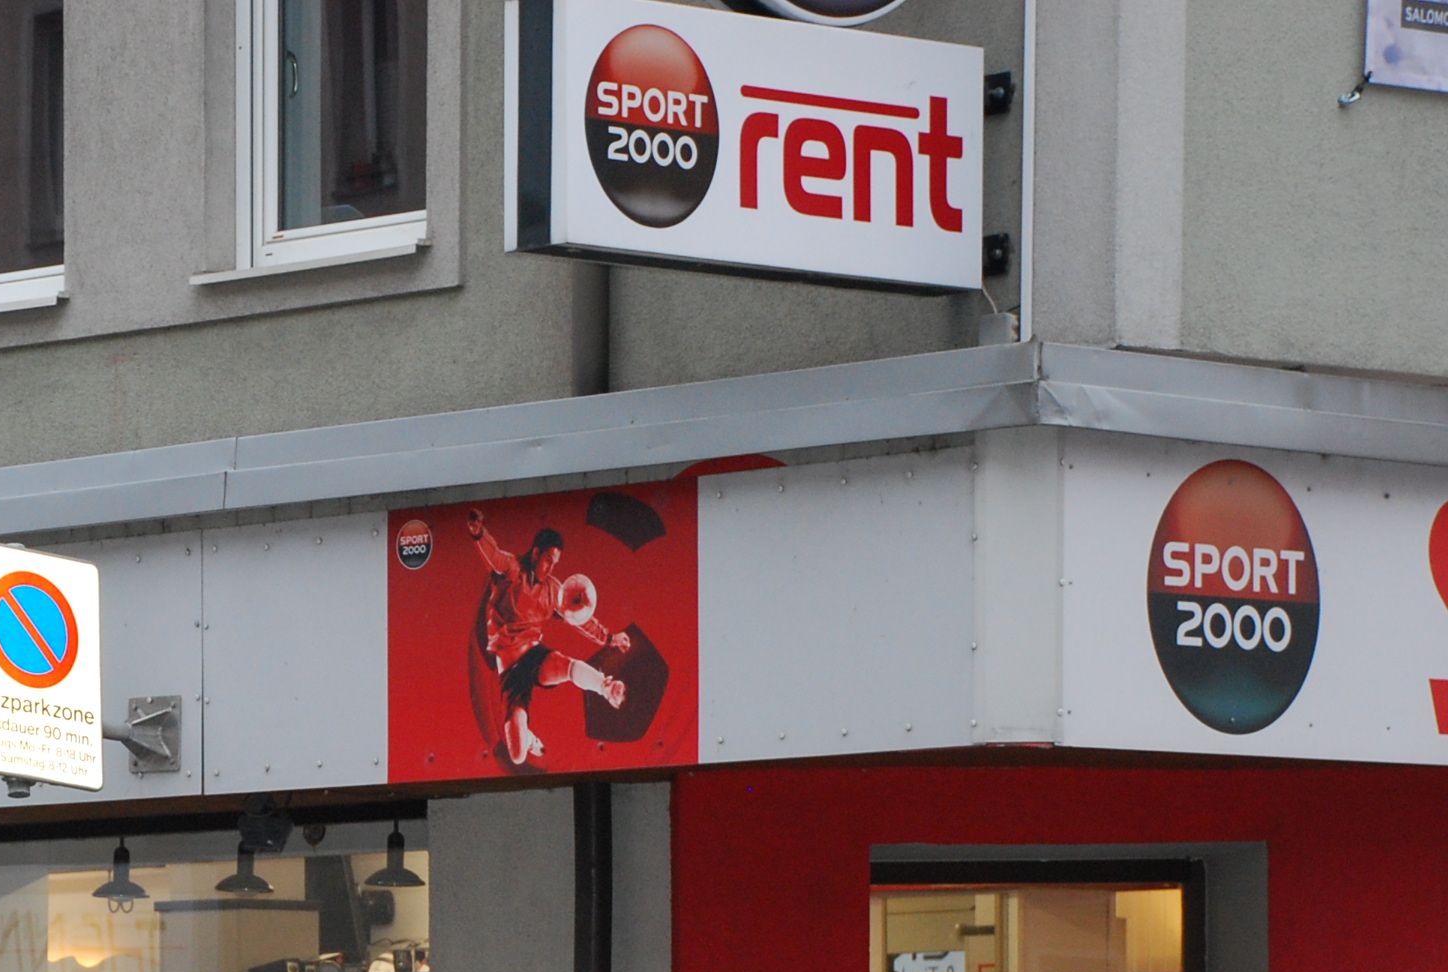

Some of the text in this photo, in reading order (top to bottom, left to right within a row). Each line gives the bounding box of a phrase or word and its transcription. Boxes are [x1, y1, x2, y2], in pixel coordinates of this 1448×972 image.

[1405, 6, 1448, 25] SALOMO
[597, 81, 709, 131] SPORT
[606, 126, 698, 170] 2000
[739, 96, 963, 233] rent
[400, 534, 429, 546] SPORT
[402, 545, 427, 556] 2000
[1162, 541, 1306, 595] SPORT
[1176, 600, 1292, 653] 2000
[43, 725, 62, 741] 90
[65, 731, 93, 746] min.
